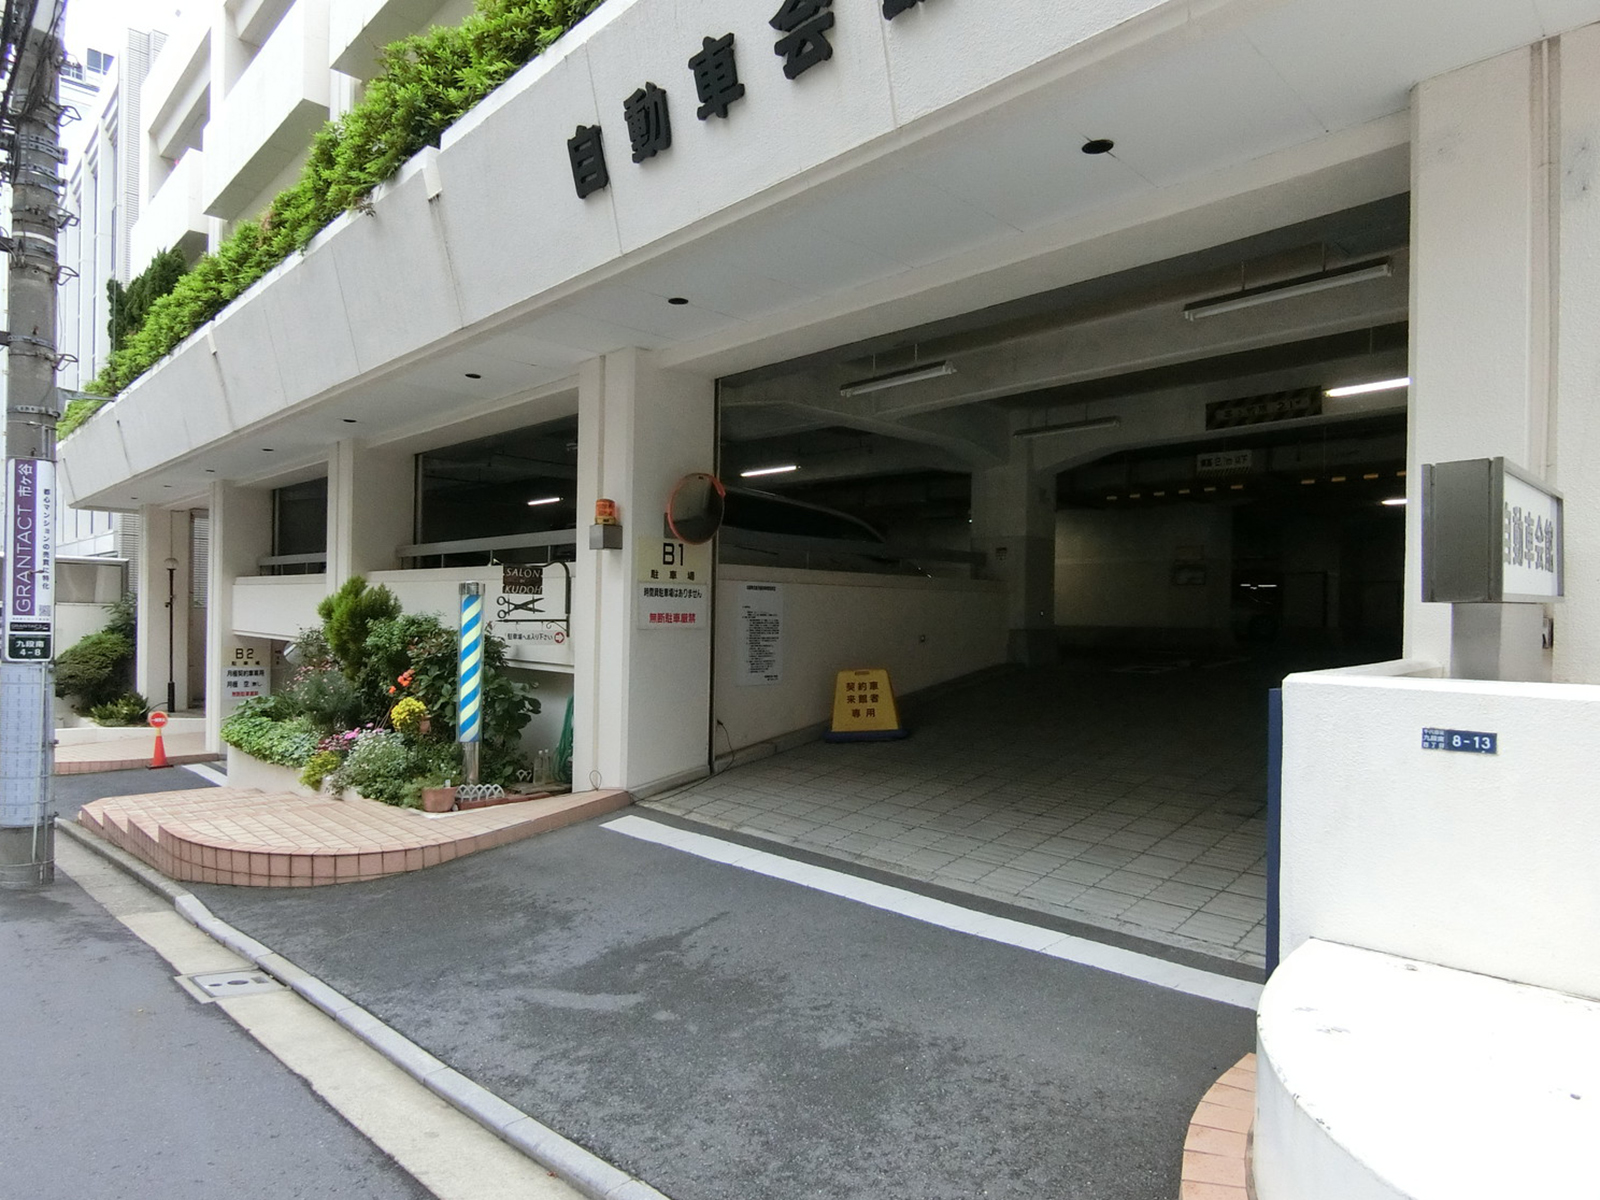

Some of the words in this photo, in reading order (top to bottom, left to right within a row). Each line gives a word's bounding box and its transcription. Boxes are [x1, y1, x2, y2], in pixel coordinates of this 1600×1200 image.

[567, 0, 925, 199] 自動車会
[16, 504, 33, 612] GRANTACT
[662, 542, 684, 566] B1
[506, 568, 541, 577] SALON
[650, 569, 695, 581] 駐車場
[504, 585, 542, 594] KUDOH
[15, 640, 44, 648] 九段南
[19, 648, 42, 656] 4-8
[235, 647, 254, 660] B2
[845, 681, 879, 692] 契約車
[851, 708, 876, 718] 専用
[1451, 734, 1491, 750] 8-13
